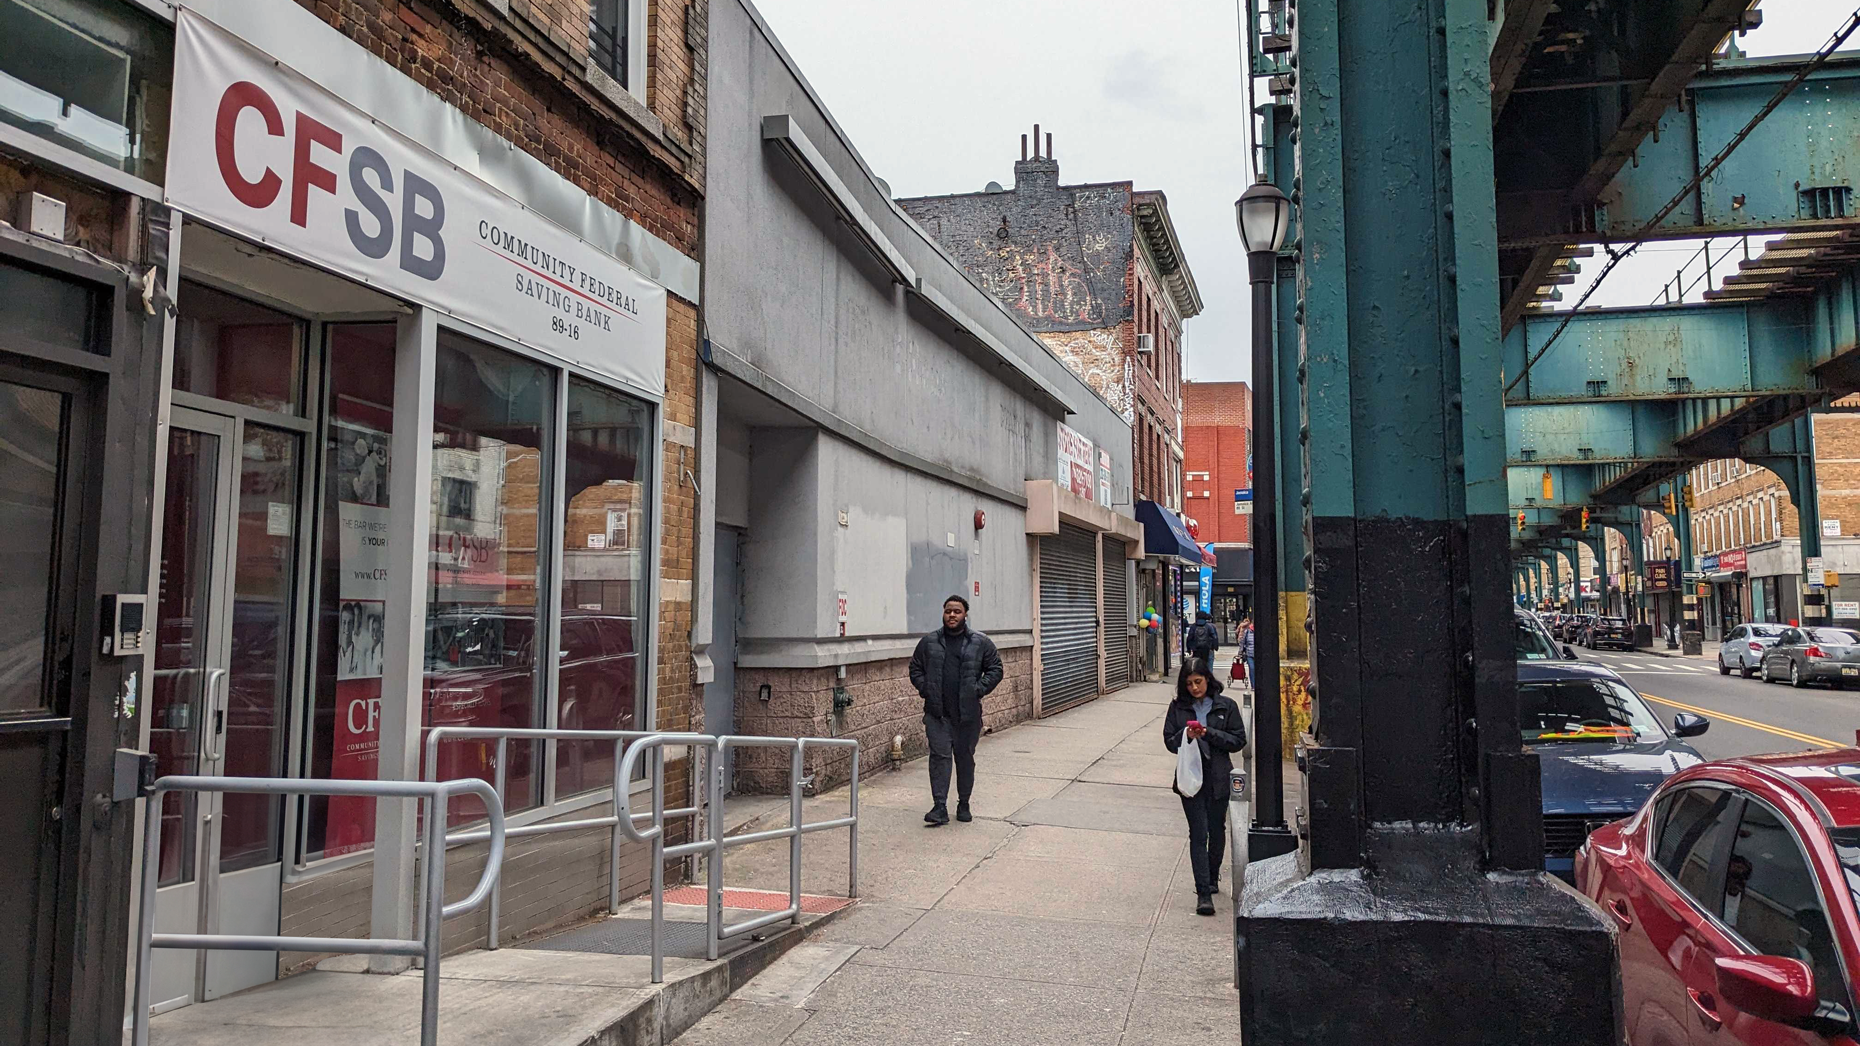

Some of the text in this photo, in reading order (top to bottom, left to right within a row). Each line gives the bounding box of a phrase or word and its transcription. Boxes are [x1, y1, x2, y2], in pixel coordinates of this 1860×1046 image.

[215, 81, 447, 282] CFSB
[478, 219, 639, 316] COMMUNITY FEDERAL
[515, 272, 612, 333] SAVING BANK
[551, 315, 580, 341] 89-16
[354, 520, 367, 531] BAR
[368, 537, 386, 547] YOUR
[1201, 576, 1210, 608] HOLA
